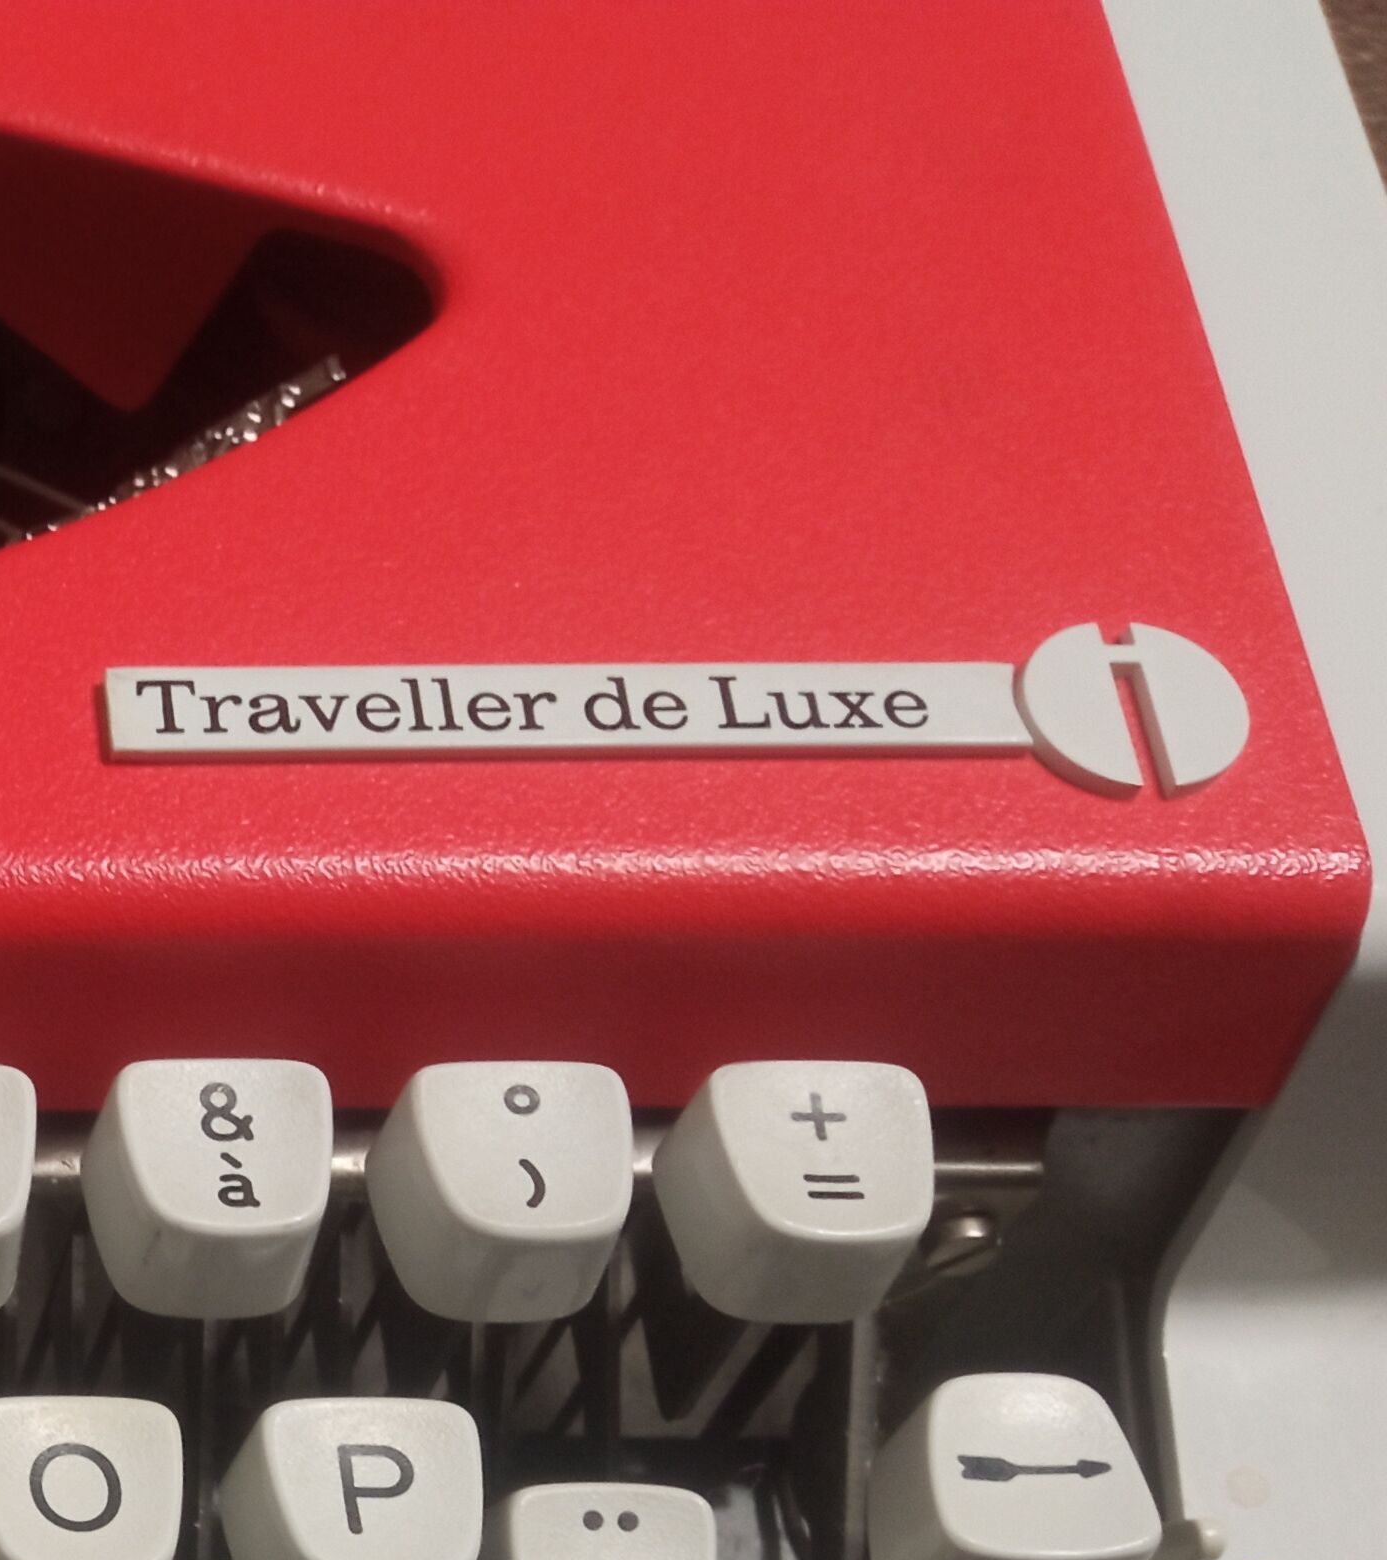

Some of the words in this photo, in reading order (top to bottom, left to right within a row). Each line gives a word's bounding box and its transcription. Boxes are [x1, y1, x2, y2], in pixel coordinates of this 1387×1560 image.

[134, 677, 558, 736] Traveller
[582, 675, 689, 732] de
[712, 675, 930, 732] Luxe
[198, 1081, 256, 1143] &
[789, 1092, 848, 1143] +
[216, 1151, 262, 1209] à
[801, 1172, 866, 1201] =
[28, 1441, 124, 1534] O
[336, 1443, 416, 1536] P
